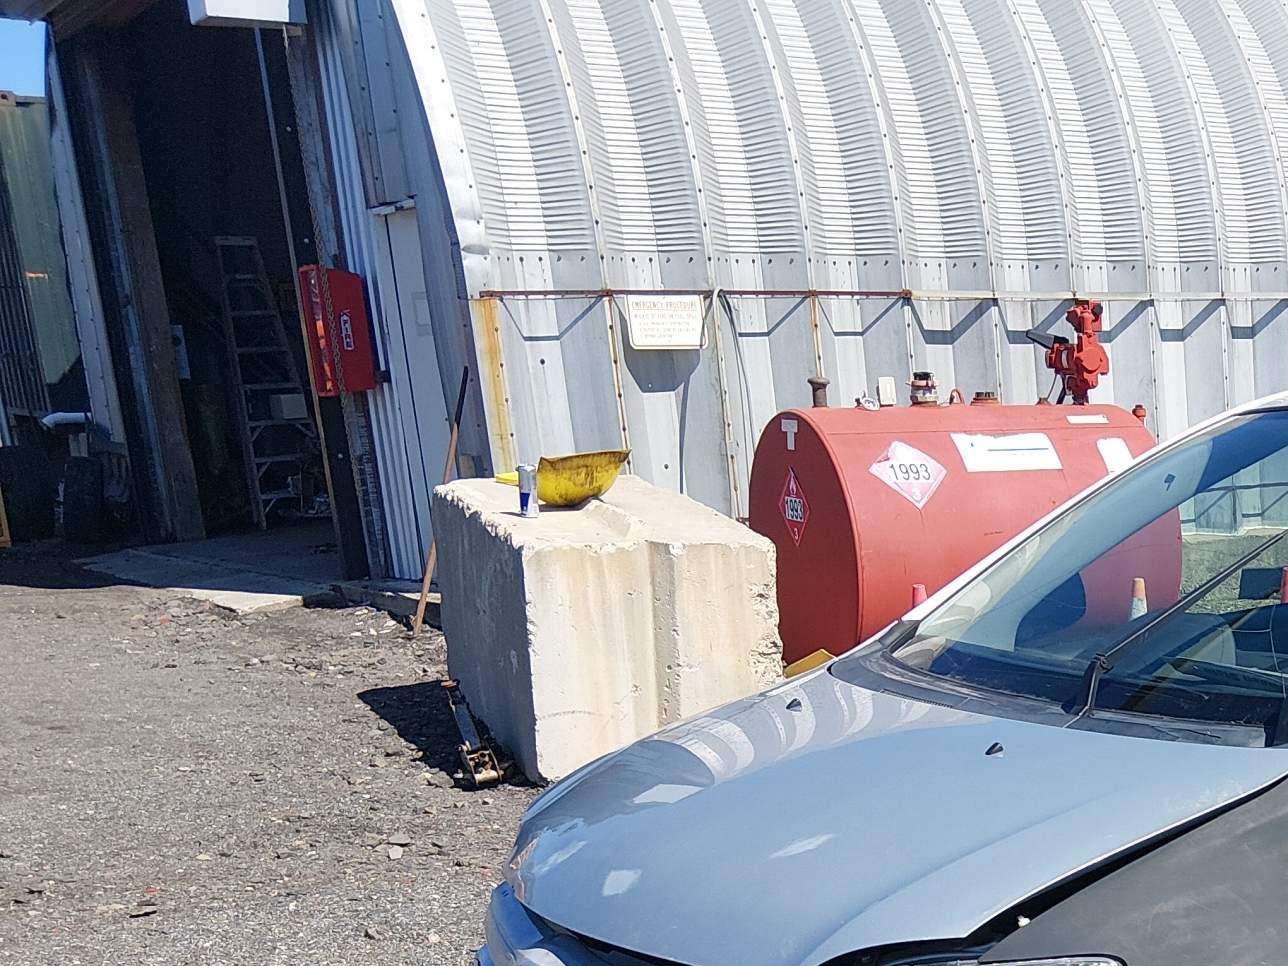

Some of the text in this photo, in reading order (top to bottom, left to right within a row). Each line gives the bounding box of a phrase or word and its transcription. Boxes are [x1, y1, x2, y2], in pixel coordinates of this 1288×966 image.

[632, 301, 664, 309] EMERGENCY
[889, 463, 931, 481] 1993
[912, 488, 921, 499] 3
[785, 498, 803, 520] 1993
[793, 527, 799, 539] 3
